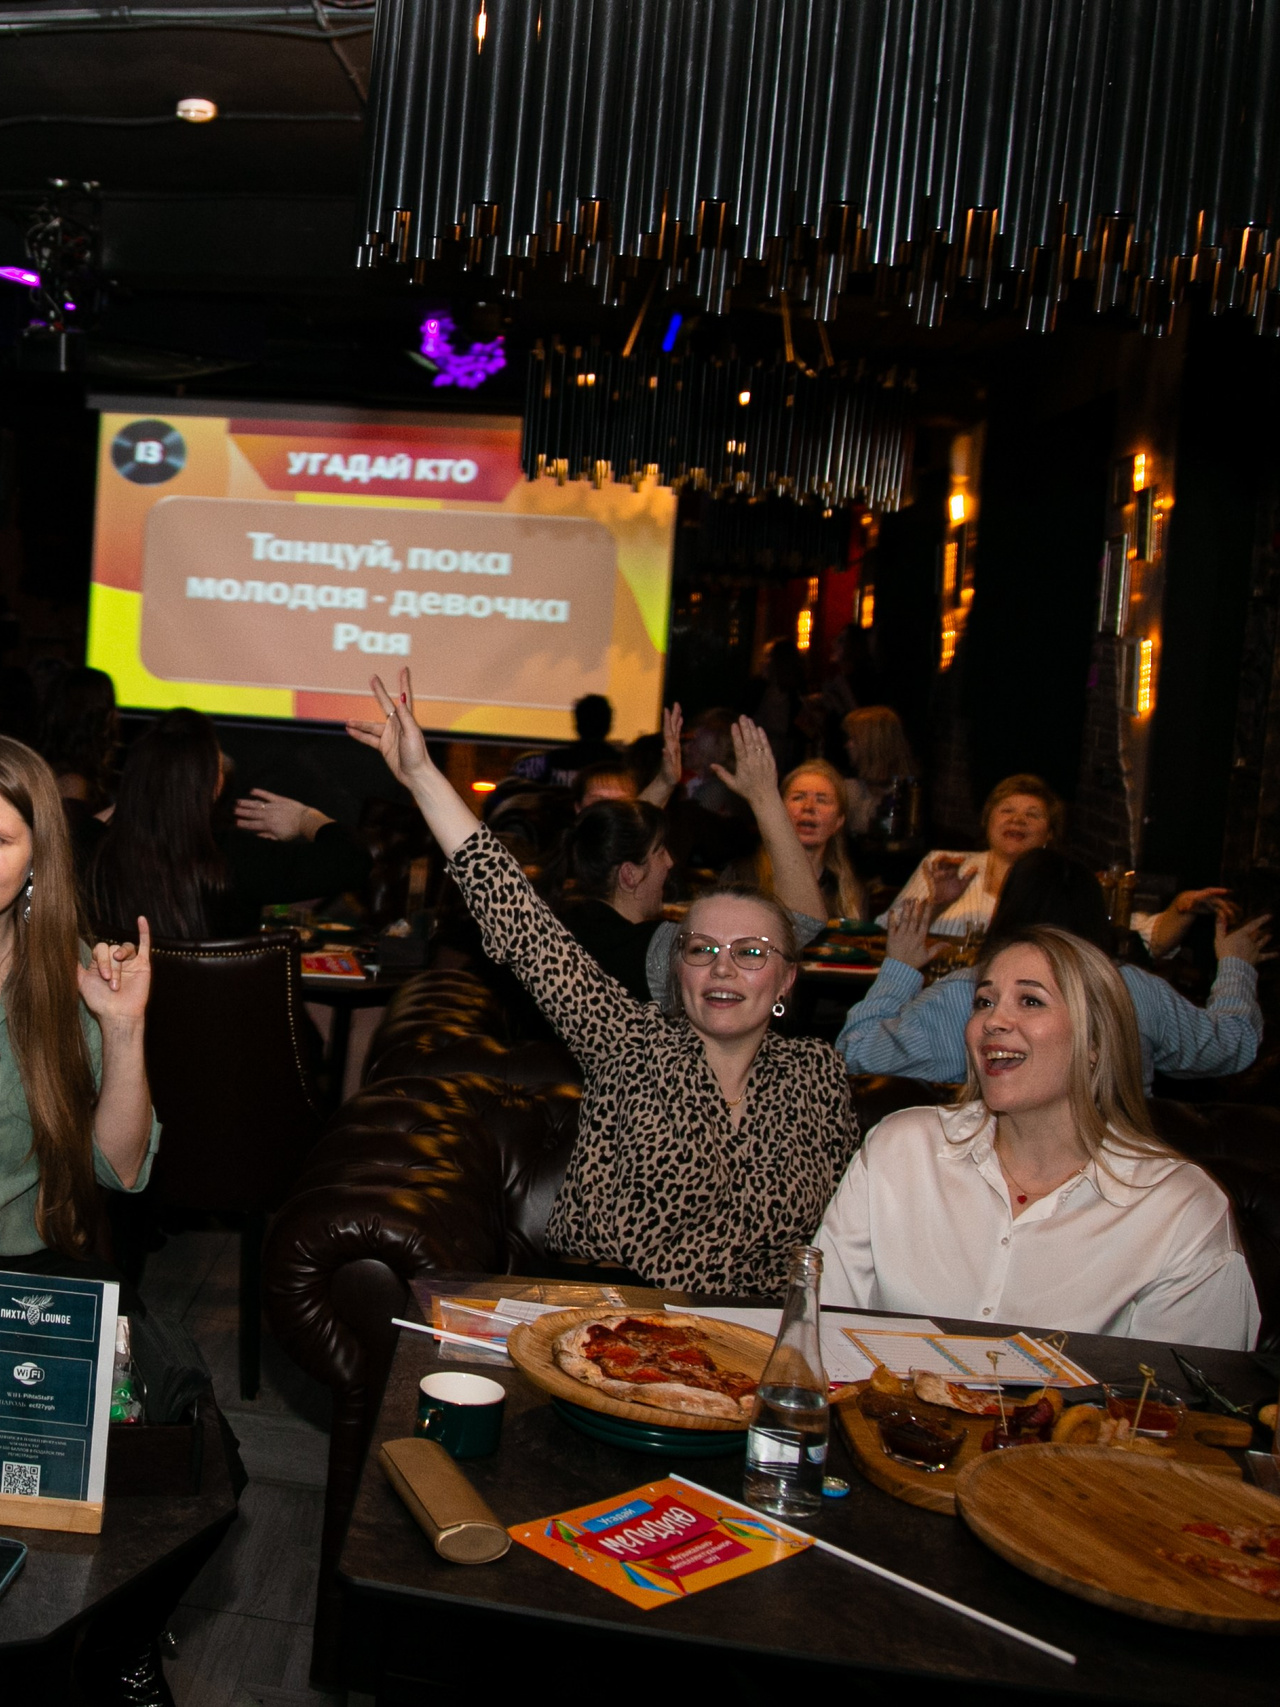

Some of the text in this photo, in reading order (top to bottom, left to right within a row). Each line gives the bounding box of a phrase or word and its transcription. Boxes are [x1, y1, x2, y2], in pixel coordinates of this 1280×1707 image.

[287, 448, 478, 484] УГАДАЙ КТО
[247, 531, 512, 577] Танцуй, пока
[186, 575, 367, 612] молодая
[390, 589, 570, 625] девочка
[333, 622, 411, 656] Рая
[0, 1308, 71, 1325] ПИХТА LOUNGE
[598, 1508, 636, 1526] Угадай
